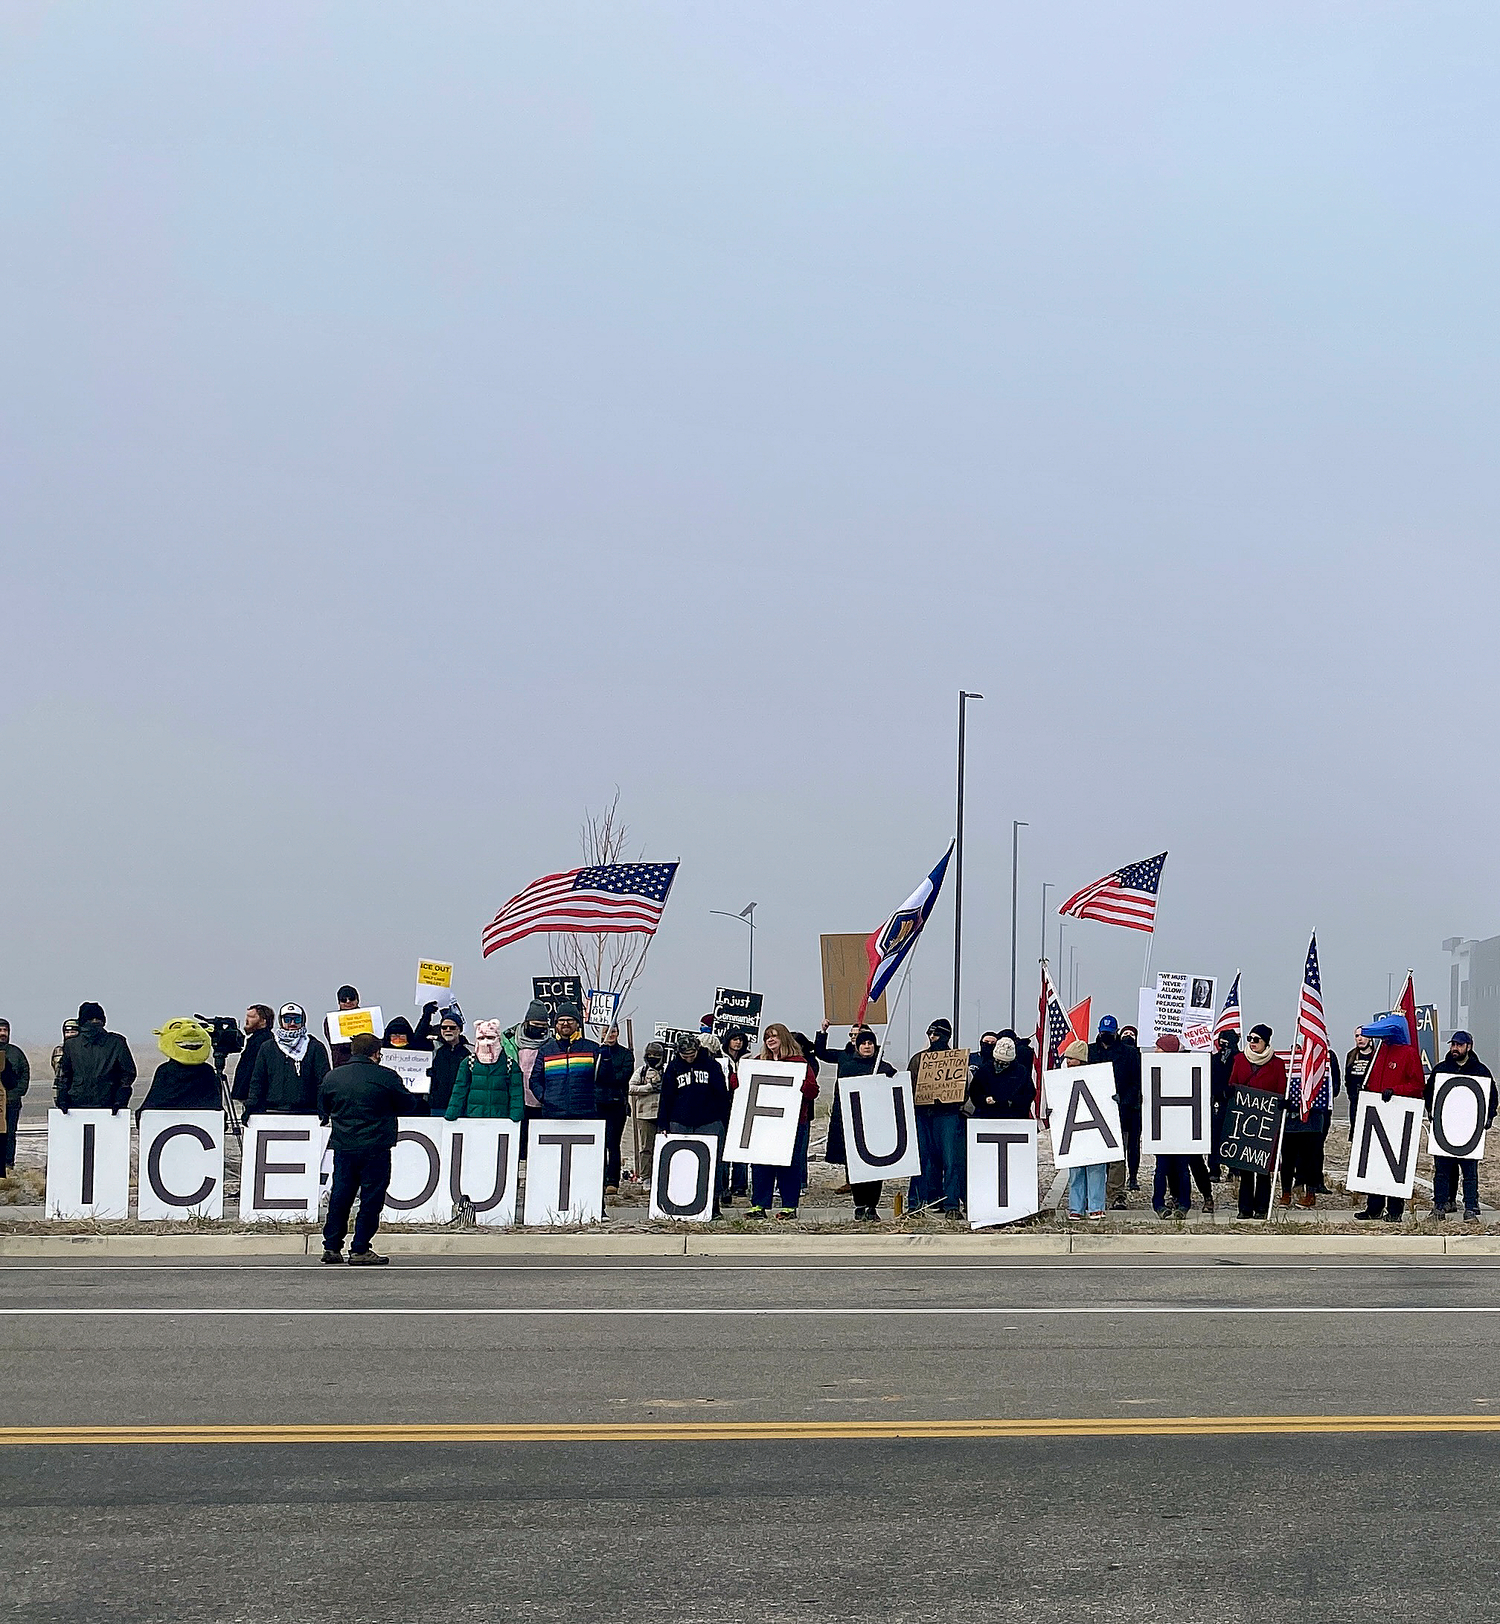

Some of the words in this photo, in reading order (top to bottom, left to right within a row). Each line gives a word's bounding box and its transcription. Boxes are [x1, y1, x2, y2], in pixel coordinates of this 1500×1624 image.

[420, 963, 433, 971] ICE
[537, 981, 575, 998] ICE
[592, 994, 613, 1009] ICE
[716, 988, 751, 1008] Injust
[1156, 1000, 1185, 1008] PREJUDICE
[591, 1006, 611, 1016] OUT
[1155, 1020, 1183, 1028] VIOLATION
[1184, 1026, 1210, 1040] NEVER
[1190, 1034, 1212, 1047] AGAIN
[923, 1051, 939, 1061] NO
[944, 1049, 961, 1059] ICE
[922, 1058, 967, 1070] DETENTION
[924, 1071, 934, 1080] IN
[934, 1068, 964, 1082] SLC
[917, 1081, 958, 1091] IMMIGRANTS
[915, 1091, 935, 1102] MAKE
[940, 1088, 964, 1102] GREAT
[1236, 1090, 1279, 1115] MAKE
[1228, 1109, 1275, 1142] ICE
[1219, 1141, 1238, 1158] GO
[1239, 1145, 1271, 1169] AWAY
